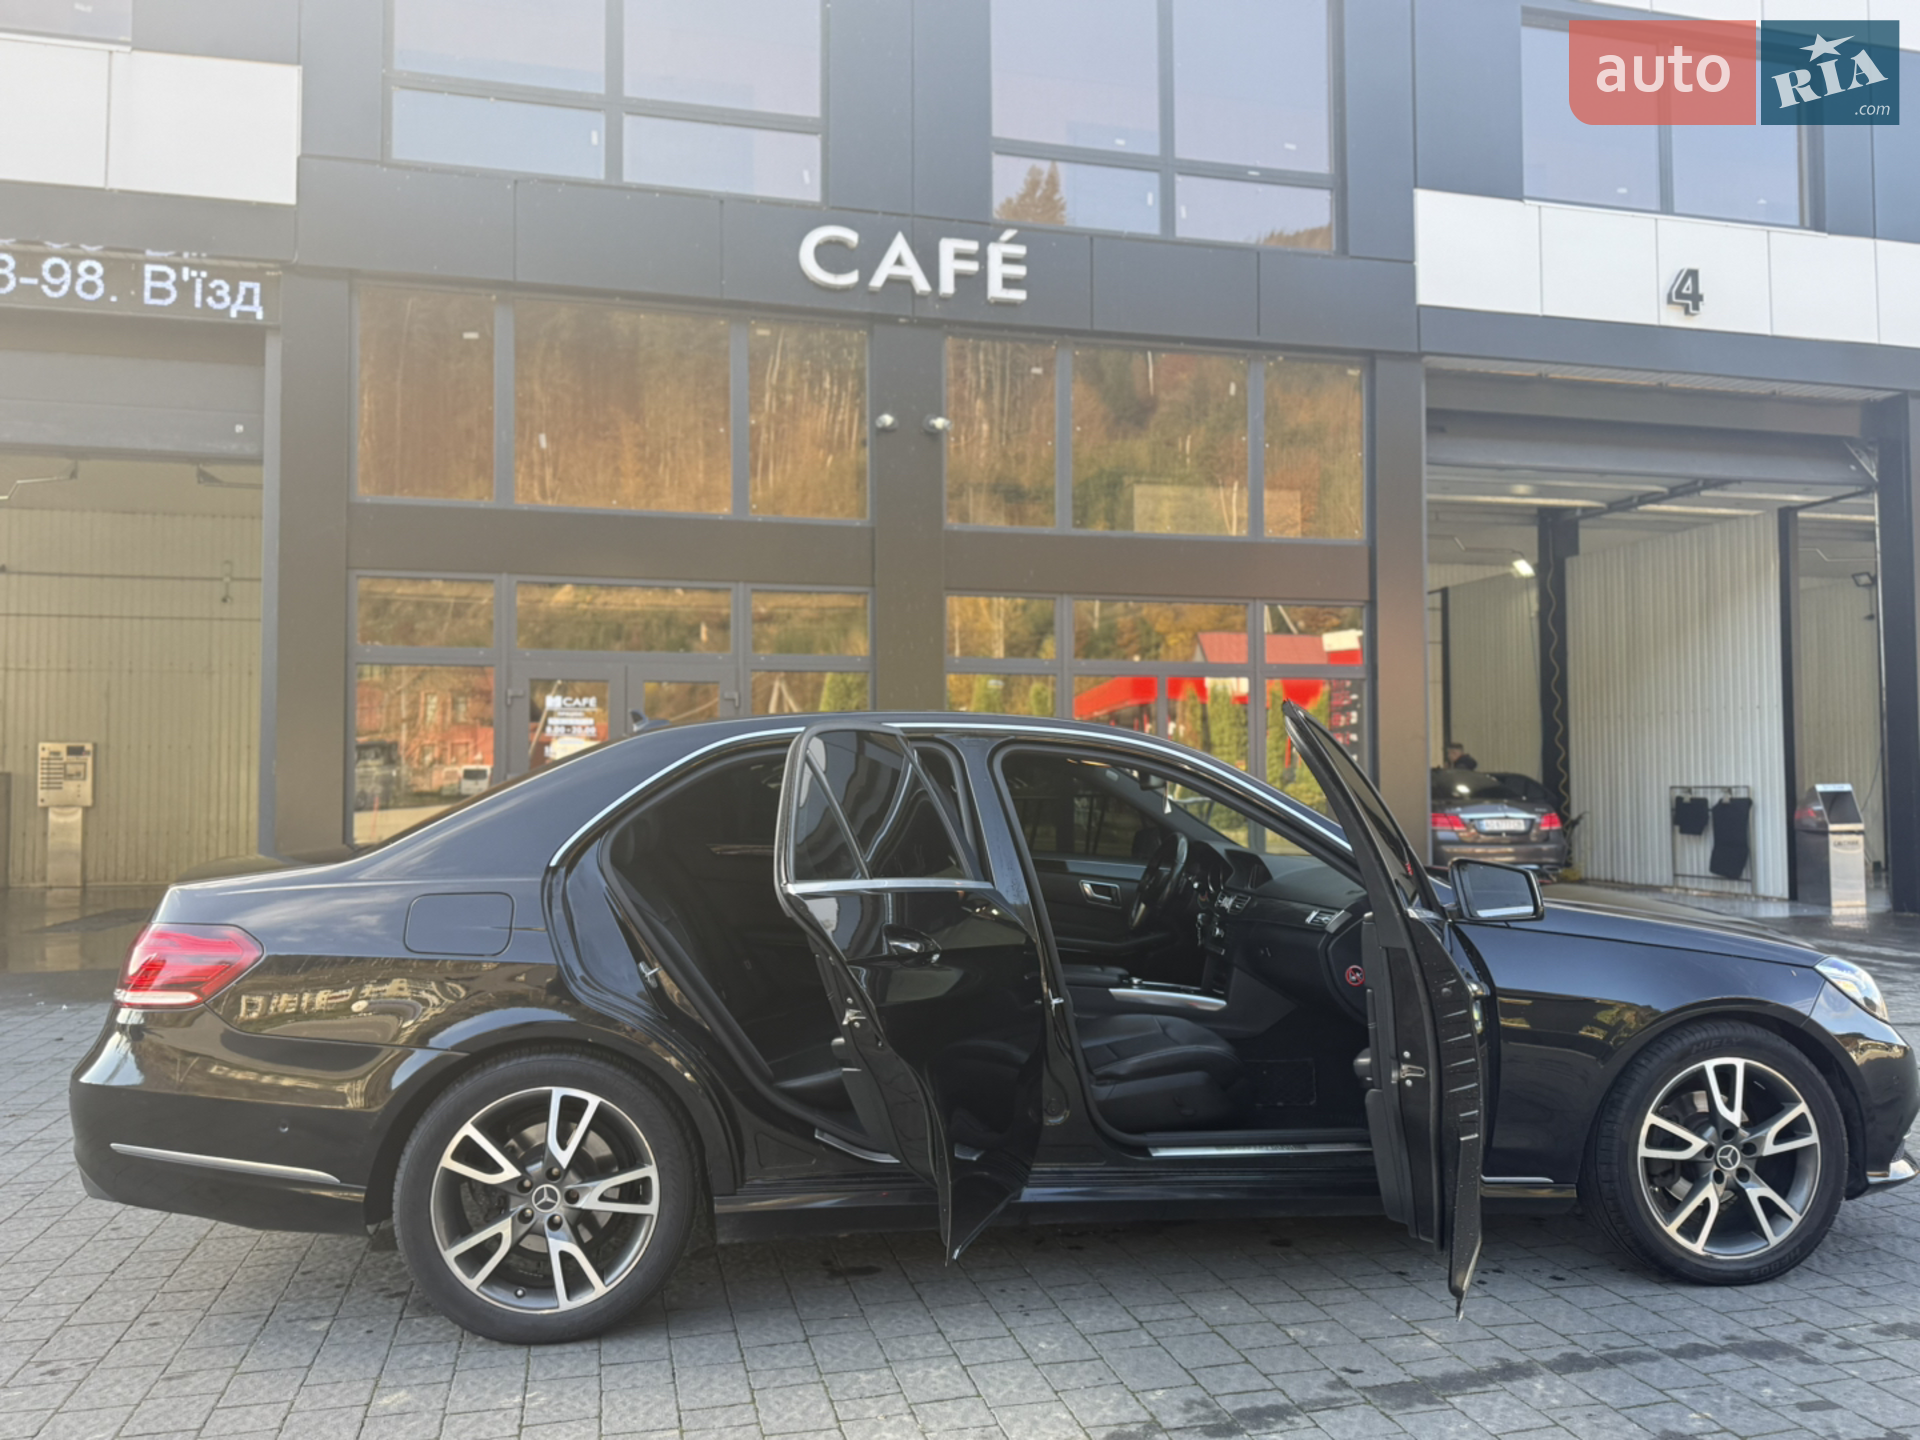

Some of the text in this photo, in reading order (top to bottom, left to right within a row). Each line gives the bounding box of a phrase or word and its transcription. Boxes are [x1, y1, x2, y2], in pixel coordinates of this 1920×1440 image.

[144, 263, 264, 320] В'їзд
[799, 225, 1028, 303] CAFÉ
[1666, 268, 1704, 316] 4
